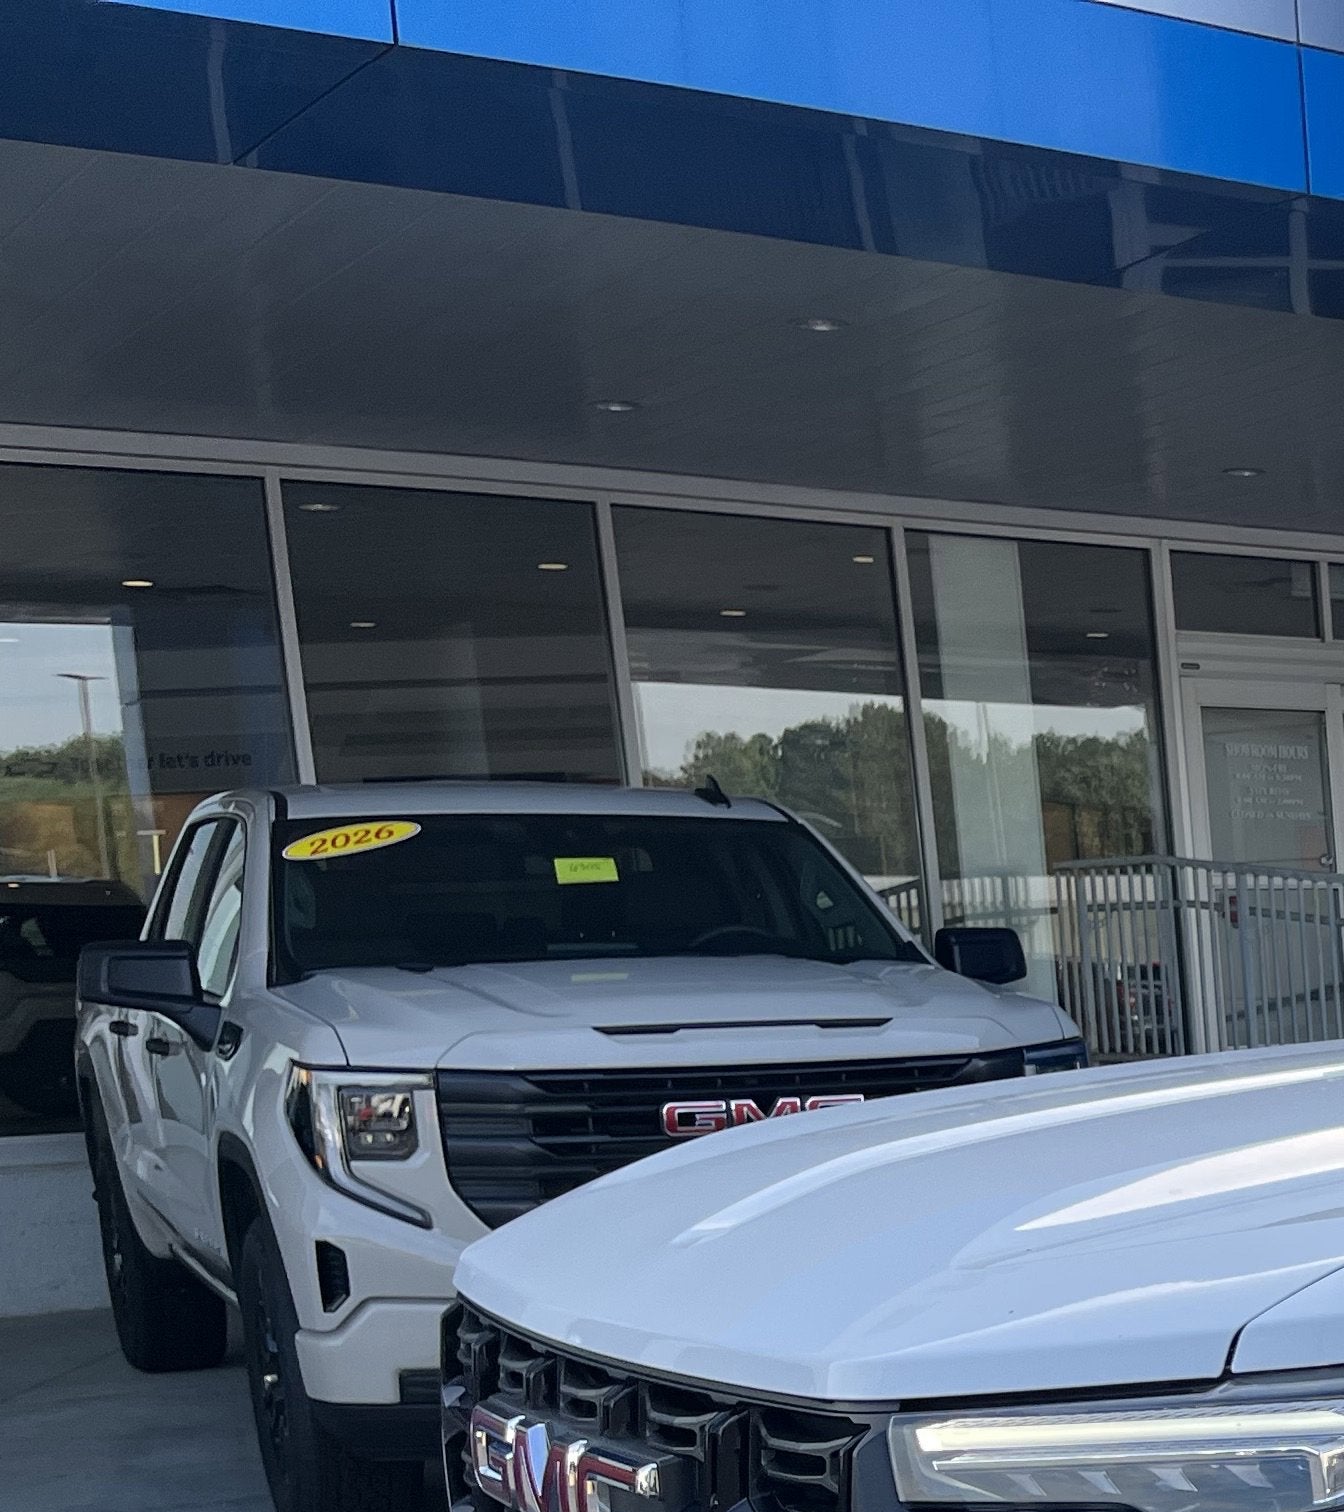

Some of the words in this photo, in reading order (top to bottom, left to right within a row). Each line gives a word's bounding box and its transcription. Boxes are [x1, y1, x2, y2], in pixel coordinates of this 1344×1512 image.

[205, 751, 251, 767] drive
[309, 824, 395, 857] 2026
[662, 1094, 866, 1138] GM
